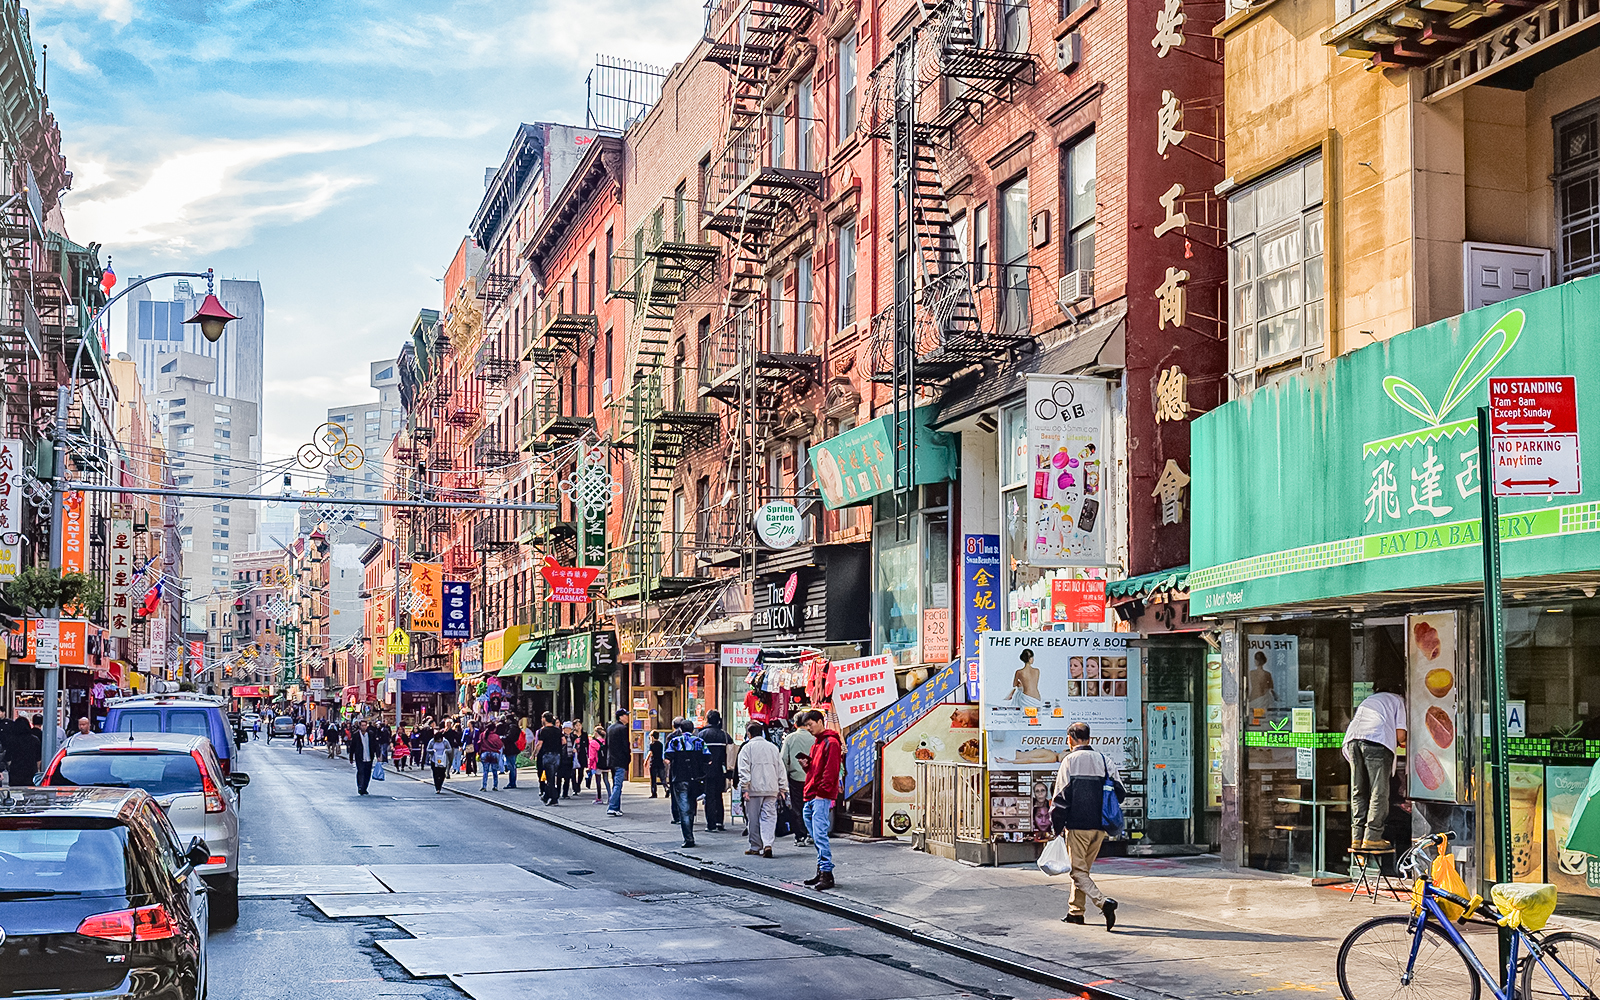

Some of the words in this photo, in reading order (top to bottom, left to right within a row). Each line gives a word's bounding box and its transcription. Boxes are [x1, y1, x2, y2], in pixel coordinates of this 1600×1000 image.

[1493, 382, 1508, 394] NO
[1511, 381, 1563, 393] STANDING
[1494, 397, 1511, 406] 7am
[1518, 397, 1535, 406] 8am
[1494, 408, 1521, 419] Except
[1523, 408, 1551, 418] Sunday
[1041, 433, 1060, 441] Beauty
[1498, 441, 1512, 452] NO
[1516, 440, 1561, 451] PARKING
[1499, 455, 1542, 468] Anytime
[1364, 445, 1481, 523] 飛達西
[767, 505, 793, 513] Spring
[67, 512, 80, 552] CANTON
[765, 522, 796, 539] Spa
[1379, 534, 1410, 555] FAY
[1414, 529, 1442, 550] DA
[1449, 514, 1537, 545] BAERY
[967, 537, 984, 554] 81
[112, 532, 130, 630] 皇上皇酒家
[551, 594, 588, 602] PHARMACY
[555, 586, 585, 594] PEOPLES
[767, 582, 785, 605] The
[450, 585, 464, 620] 456
[1205, 594, 1212, 609] 83
[1225, 588, 1244, 605] Street
[414, 619, 439, 628] WONG
[767, 604, 795, 630] YEON
[594, 634, 613, 665] 天仁
[989, 637, 1011, 647] THE
[1014, 637, 1044, 647] PURE
[1047, 637, 1090, 647] BEAUTY
[1093, 637, 1100, 647] &
[1104, 637, 1127, 647] BOD
[833, 656, 888, 674] PERFUME
[837, 671, 886, 688] T-SHIRT
[840, 685, 885, 701] WATCH
[788, 703, 802, 711] NY
[849, 701, 878, 714] BELT
[851, 703, 905, 746] FACIAL
[910, 691, 920, 703] &
[925, 667, 954, 692] SPA
[1508, 707, 1521, 728] A
[1021, 736, 1064, 745] FOREVER
[1102, 736, 1121, 745] DAY
[1123, 736, 1139, 745] SPA
